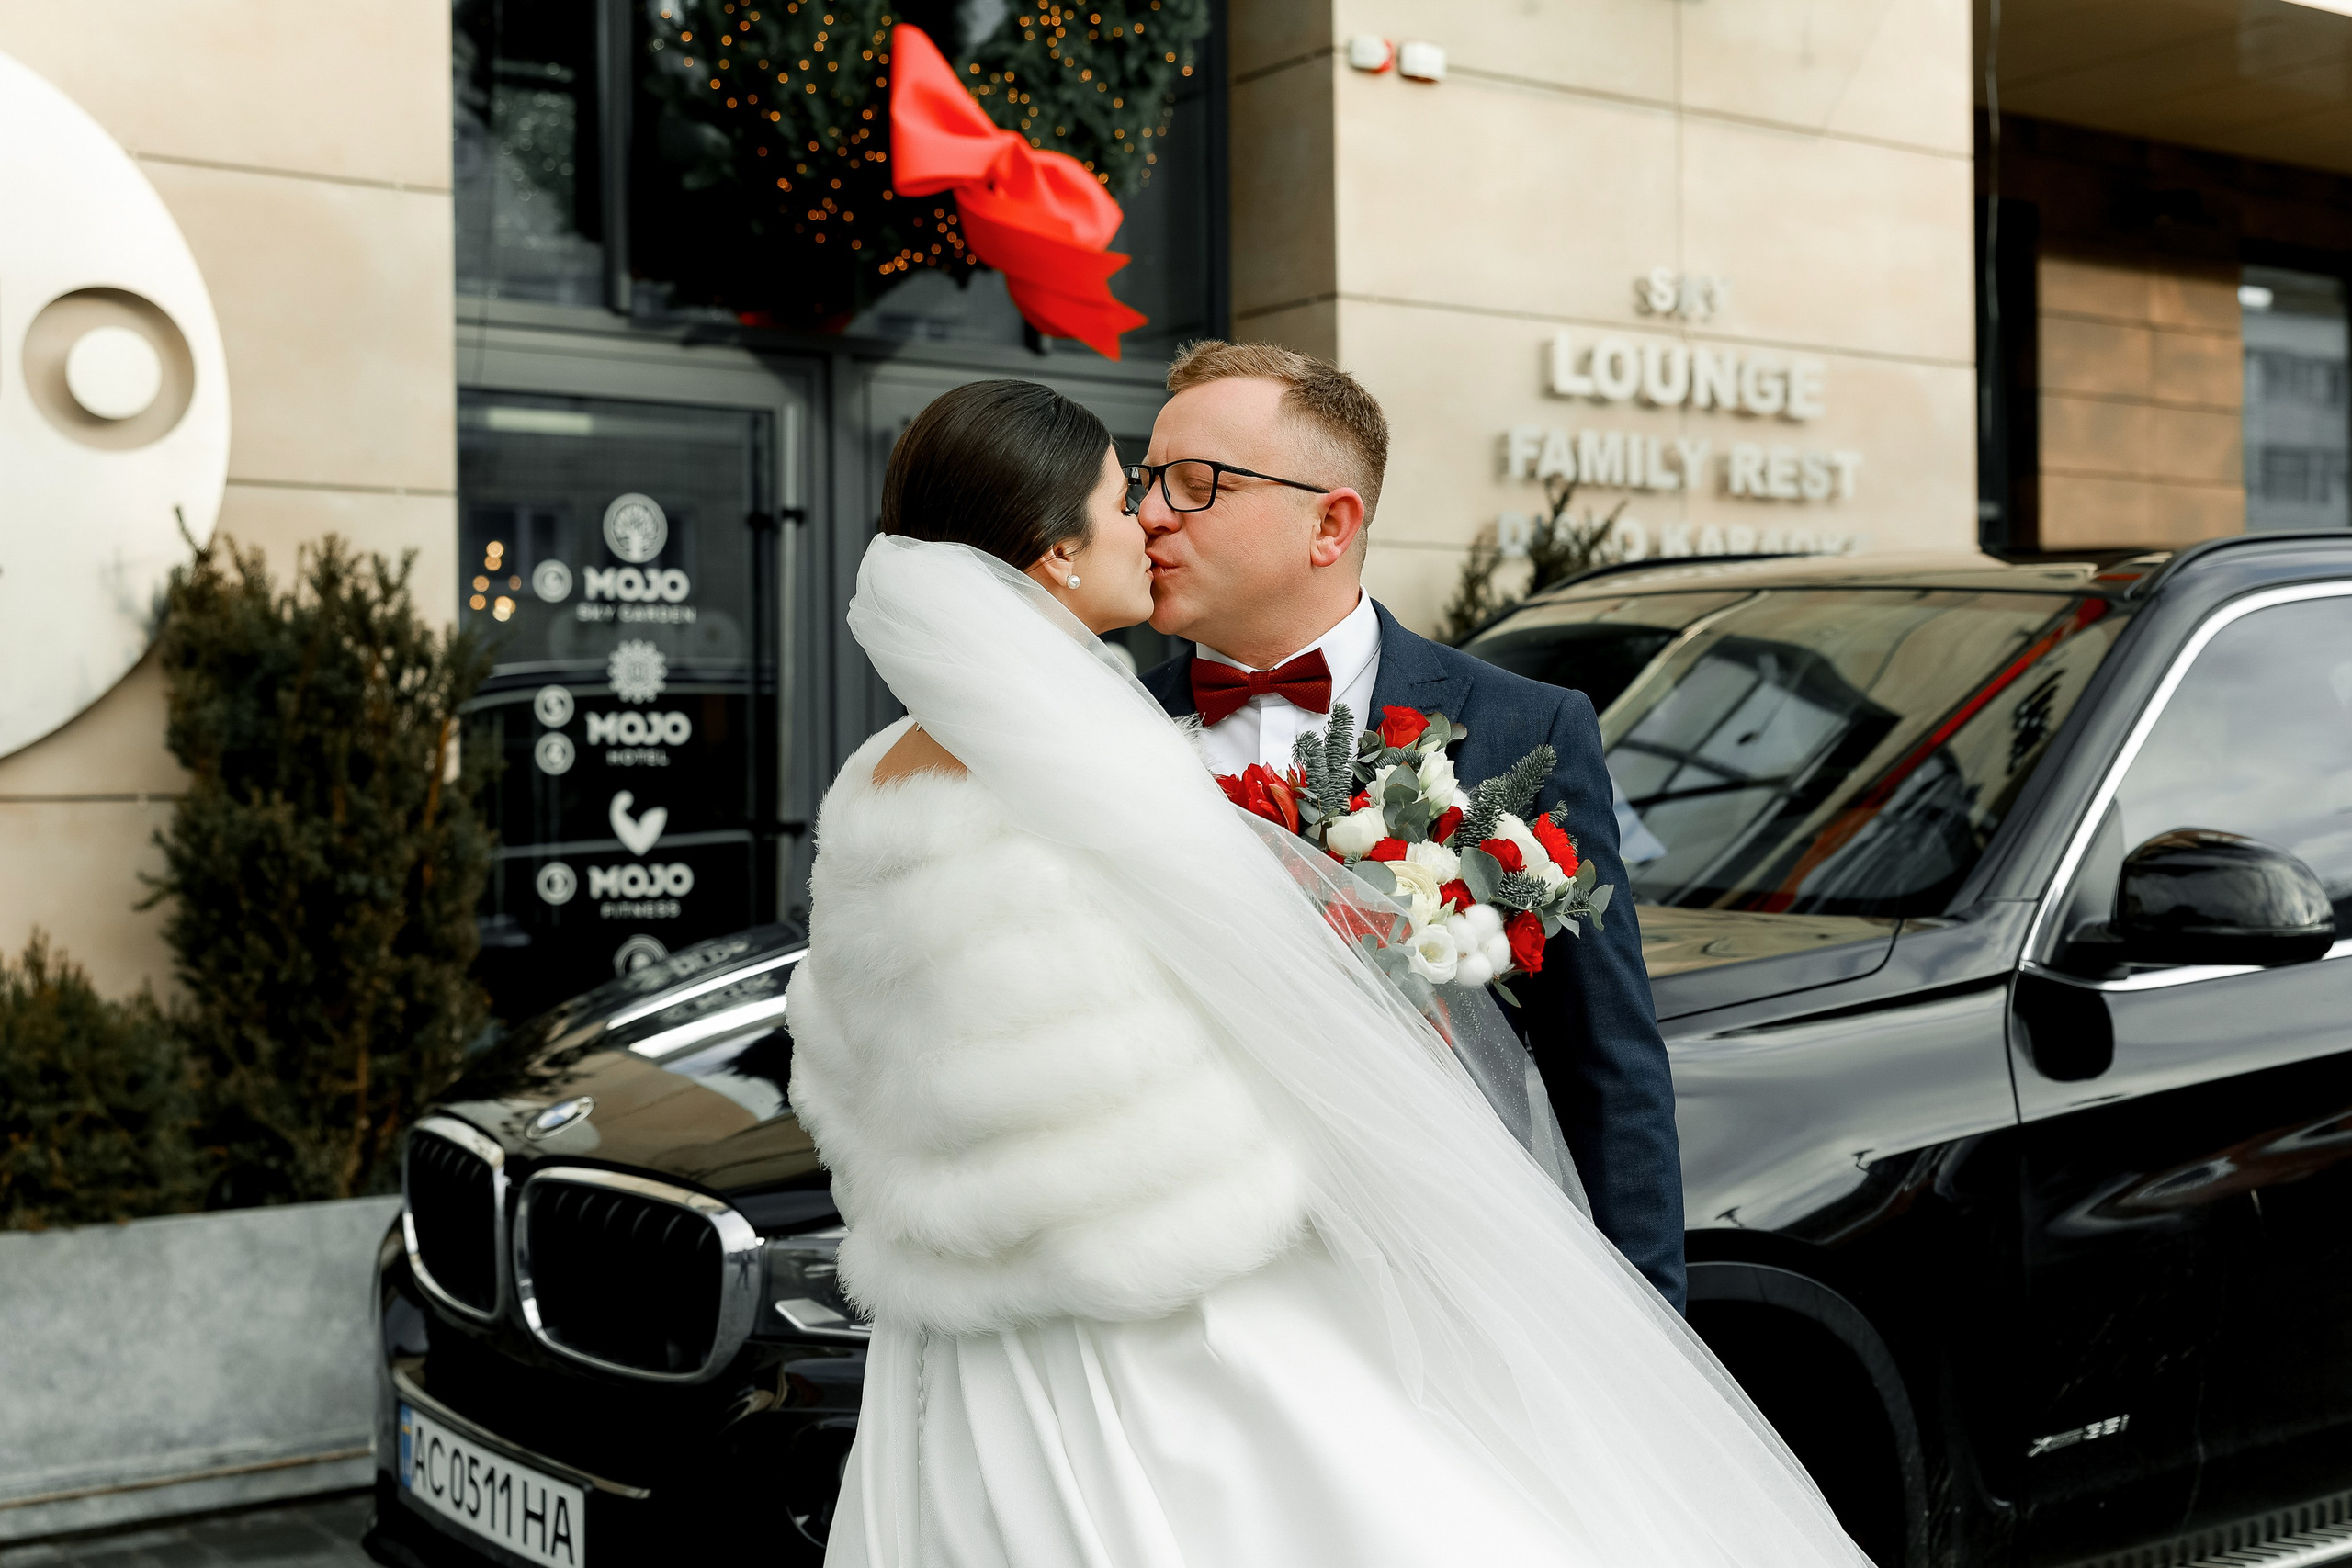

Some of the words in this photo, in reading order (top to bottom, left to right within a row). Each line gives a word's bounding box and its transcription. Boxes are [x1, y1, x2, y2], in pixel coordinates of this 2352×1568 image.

[1551, 332, 1826, 420] LOUNGE
[1507, 423, 1711, 491] FAMILY
[1729, 442, 1863, 500] REST
[582, 565, 691, 603] MOJO
[584, 710, 693, 746] MOJO
[586, 862, 695, 899] MOJO
